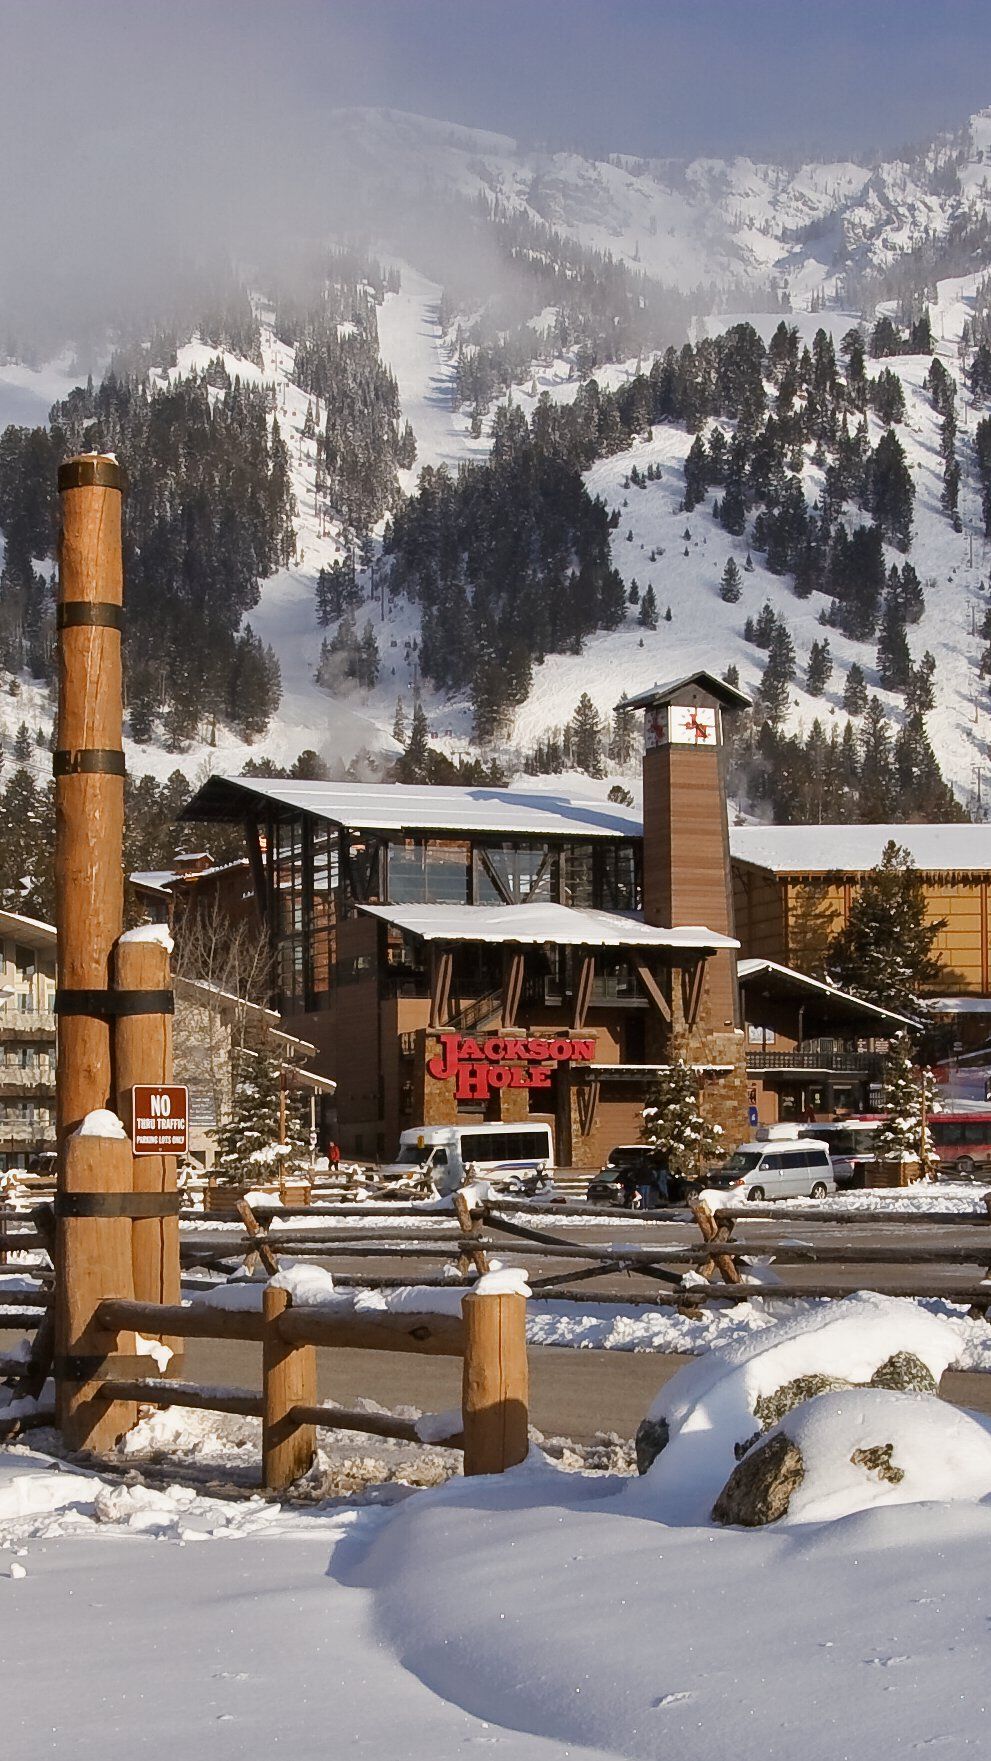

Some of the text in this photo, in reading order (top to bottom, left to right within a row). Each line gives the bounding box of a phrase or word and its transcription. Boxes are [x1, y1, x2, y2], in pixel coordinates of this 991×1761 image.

[428, 1033, 595, 1079] JACKSON
[454, 1063, 552, 1100] HOLE
[150, 1094, 171, 1117] NO
[136, 1118, 185, 1130] THRU TRAFFIC
